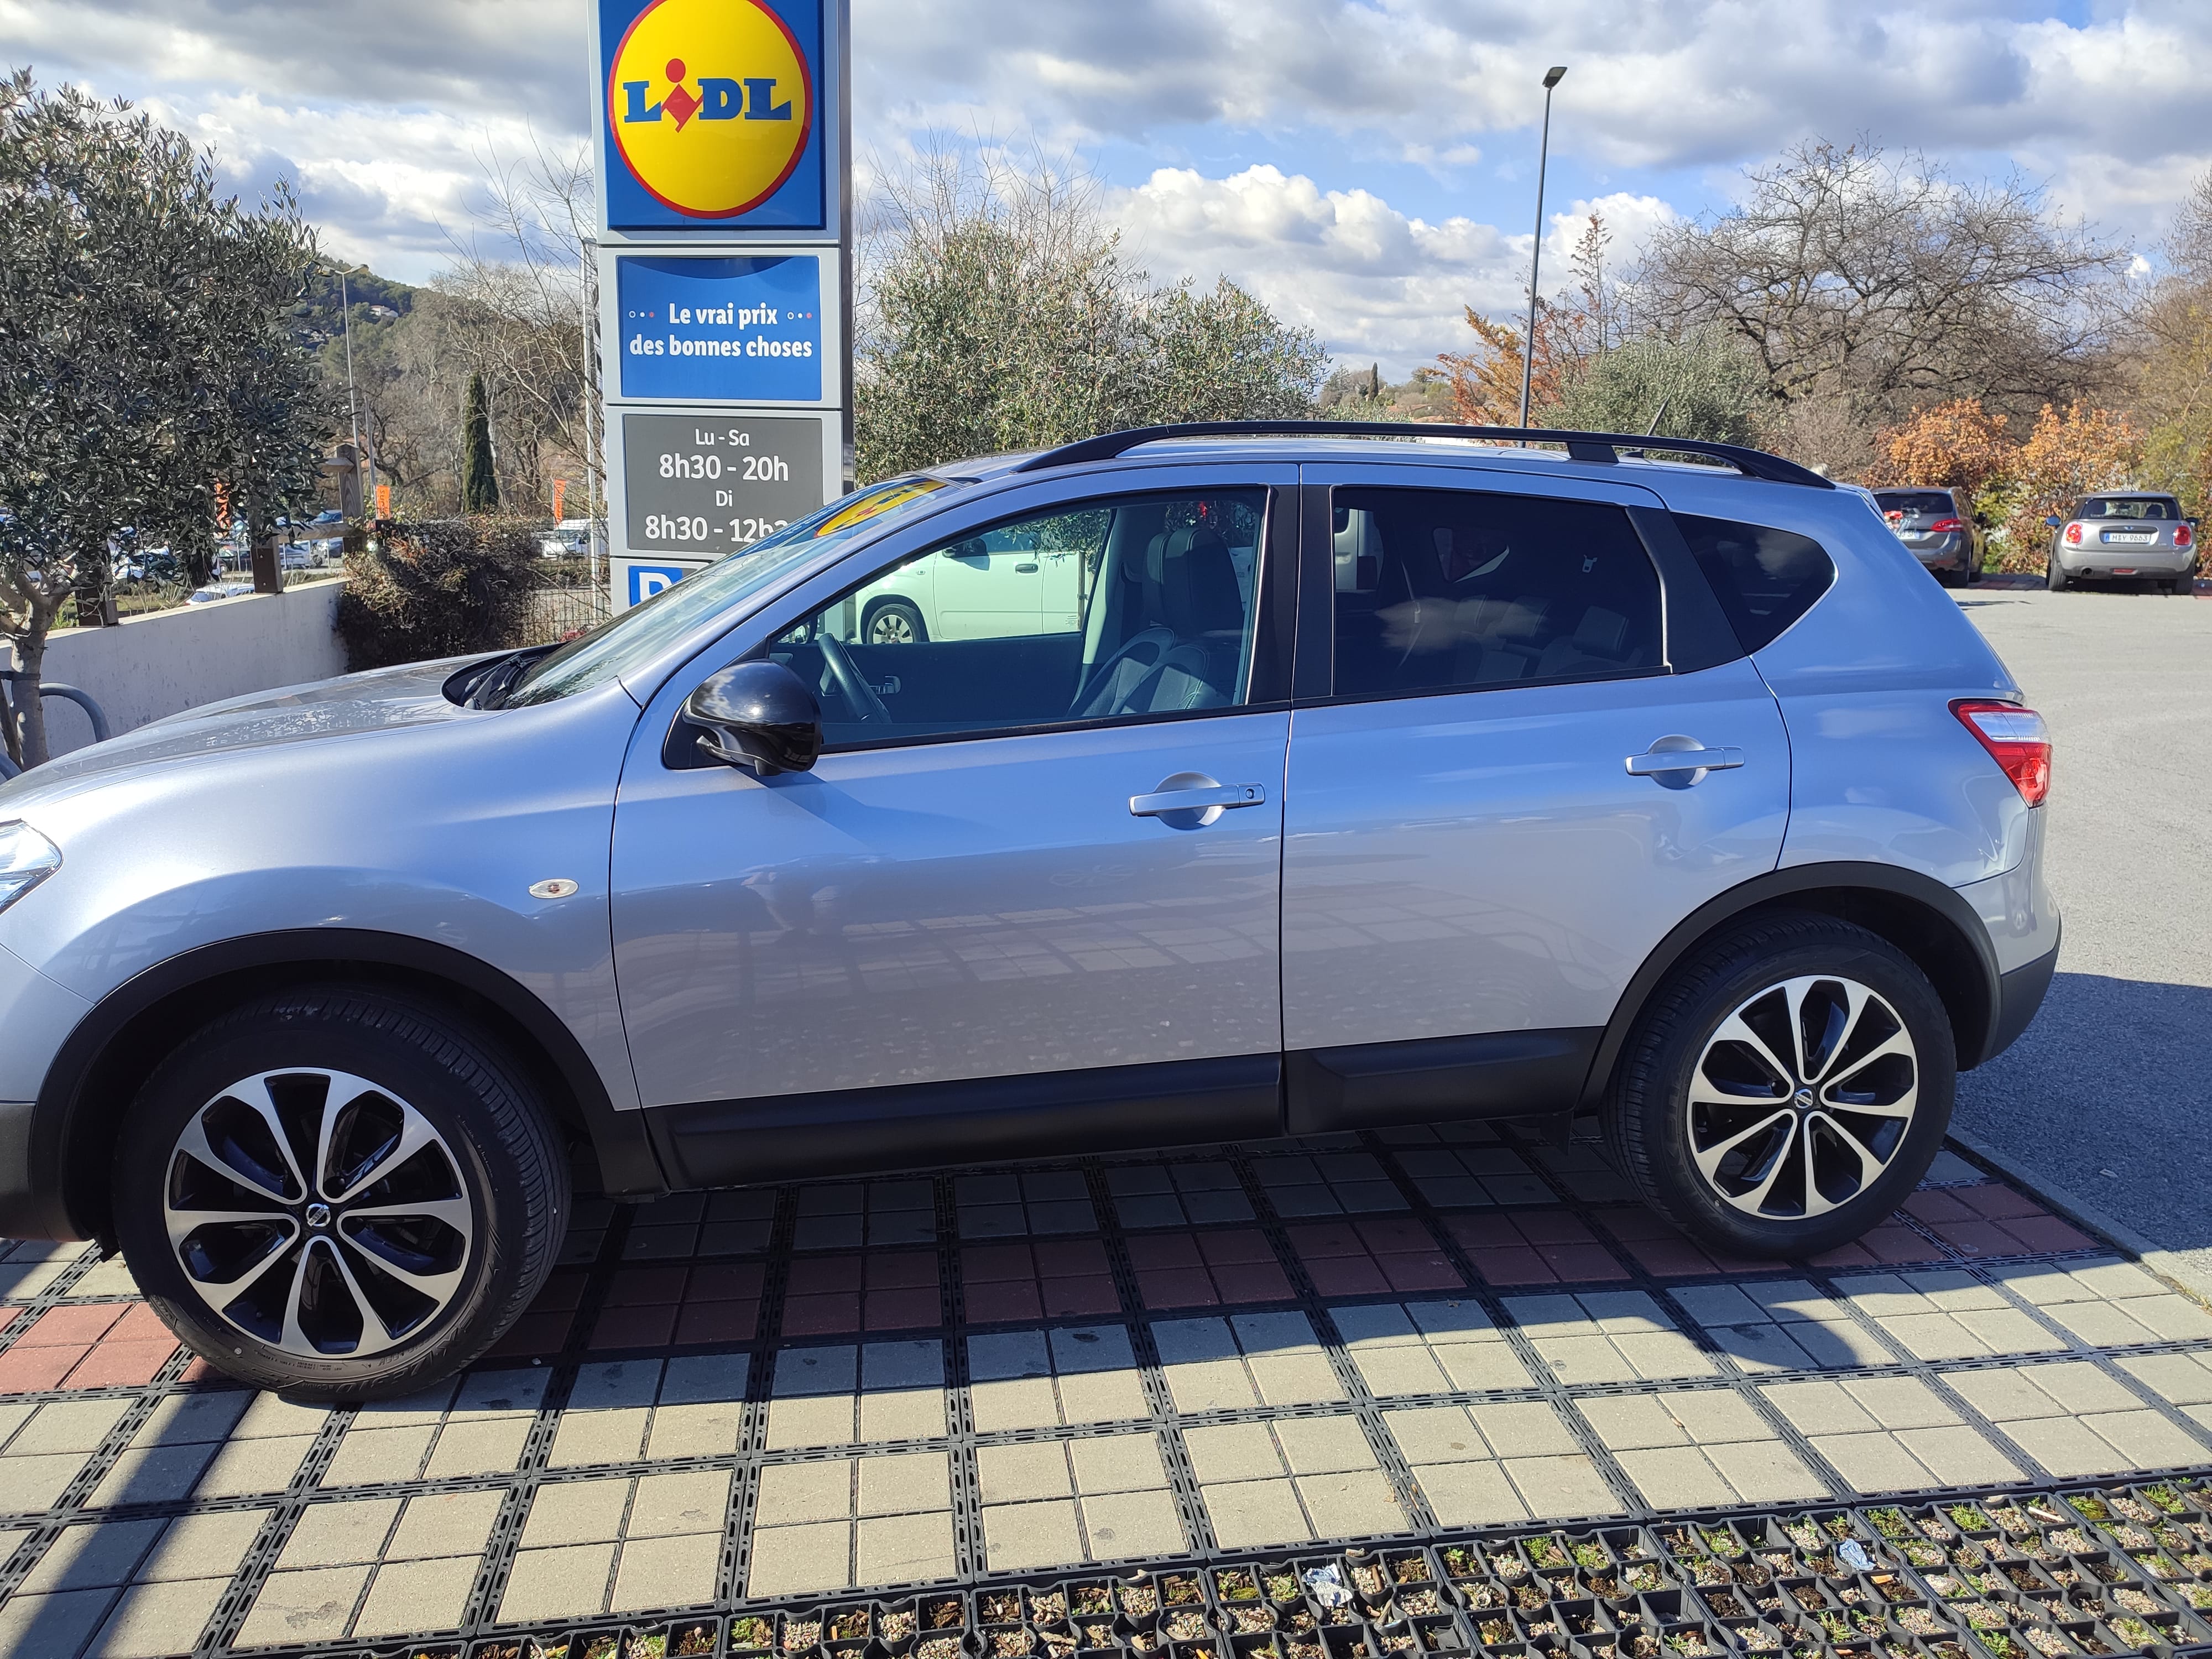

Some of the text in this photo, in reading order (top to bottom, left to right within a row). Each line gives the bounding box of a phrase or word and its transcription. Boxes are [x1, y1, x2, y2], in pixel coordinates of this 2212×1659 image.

[669, 302, 778, 330] Le vrai prix
[629, 333, 812, 357] des bonnes choses
[695, 429, 714, 445] Lu
[728, 429, 750, 446] Sa
[659, 452, 721, 479] 8h30
[742, 455, 789, 481] 20h
[716, 489, 733, 507] Di
[645, 514, 708, 541] 8h30
